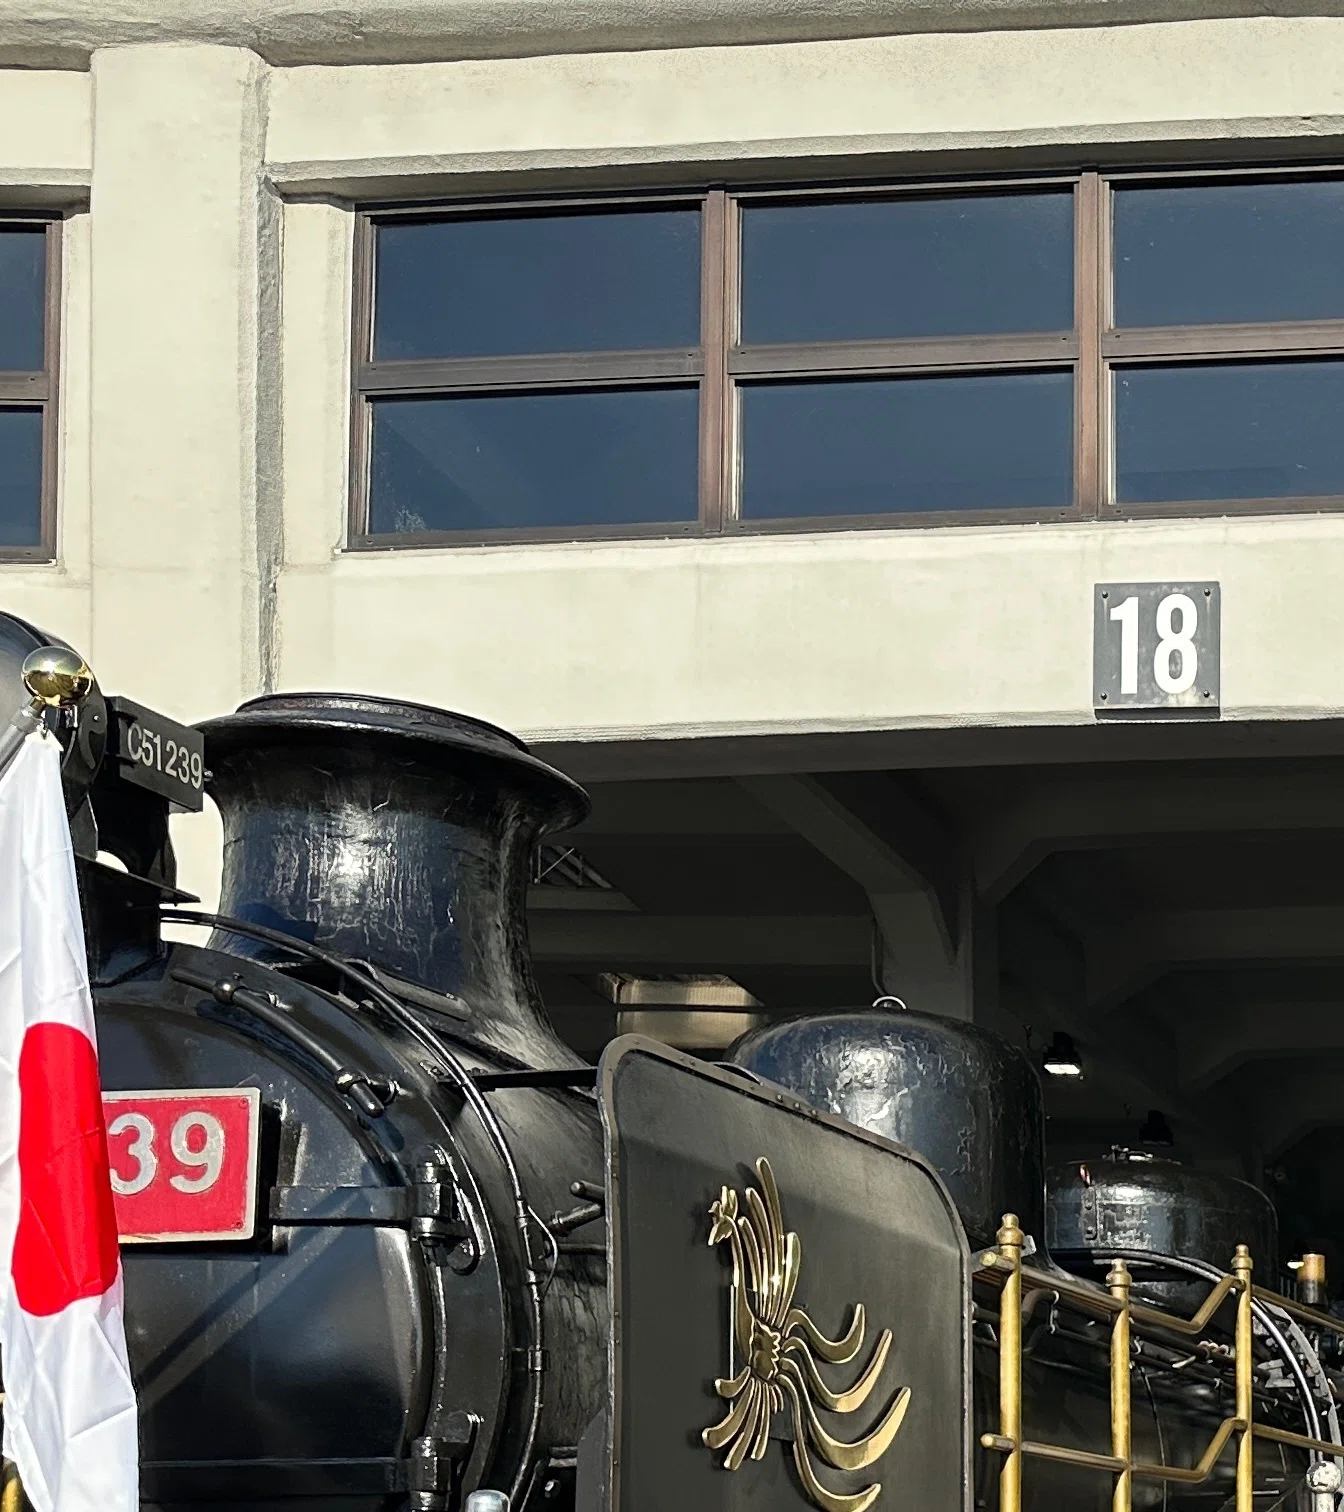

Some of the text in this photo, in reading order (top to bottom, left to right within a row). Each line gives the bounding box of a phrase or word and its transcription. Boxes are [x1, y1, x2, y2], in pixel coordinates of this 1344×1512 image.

[1110, 593, 1198, 695] 18
[127, 723, 202, 789] C51239
[109, 1111, 225, 1195] 39
